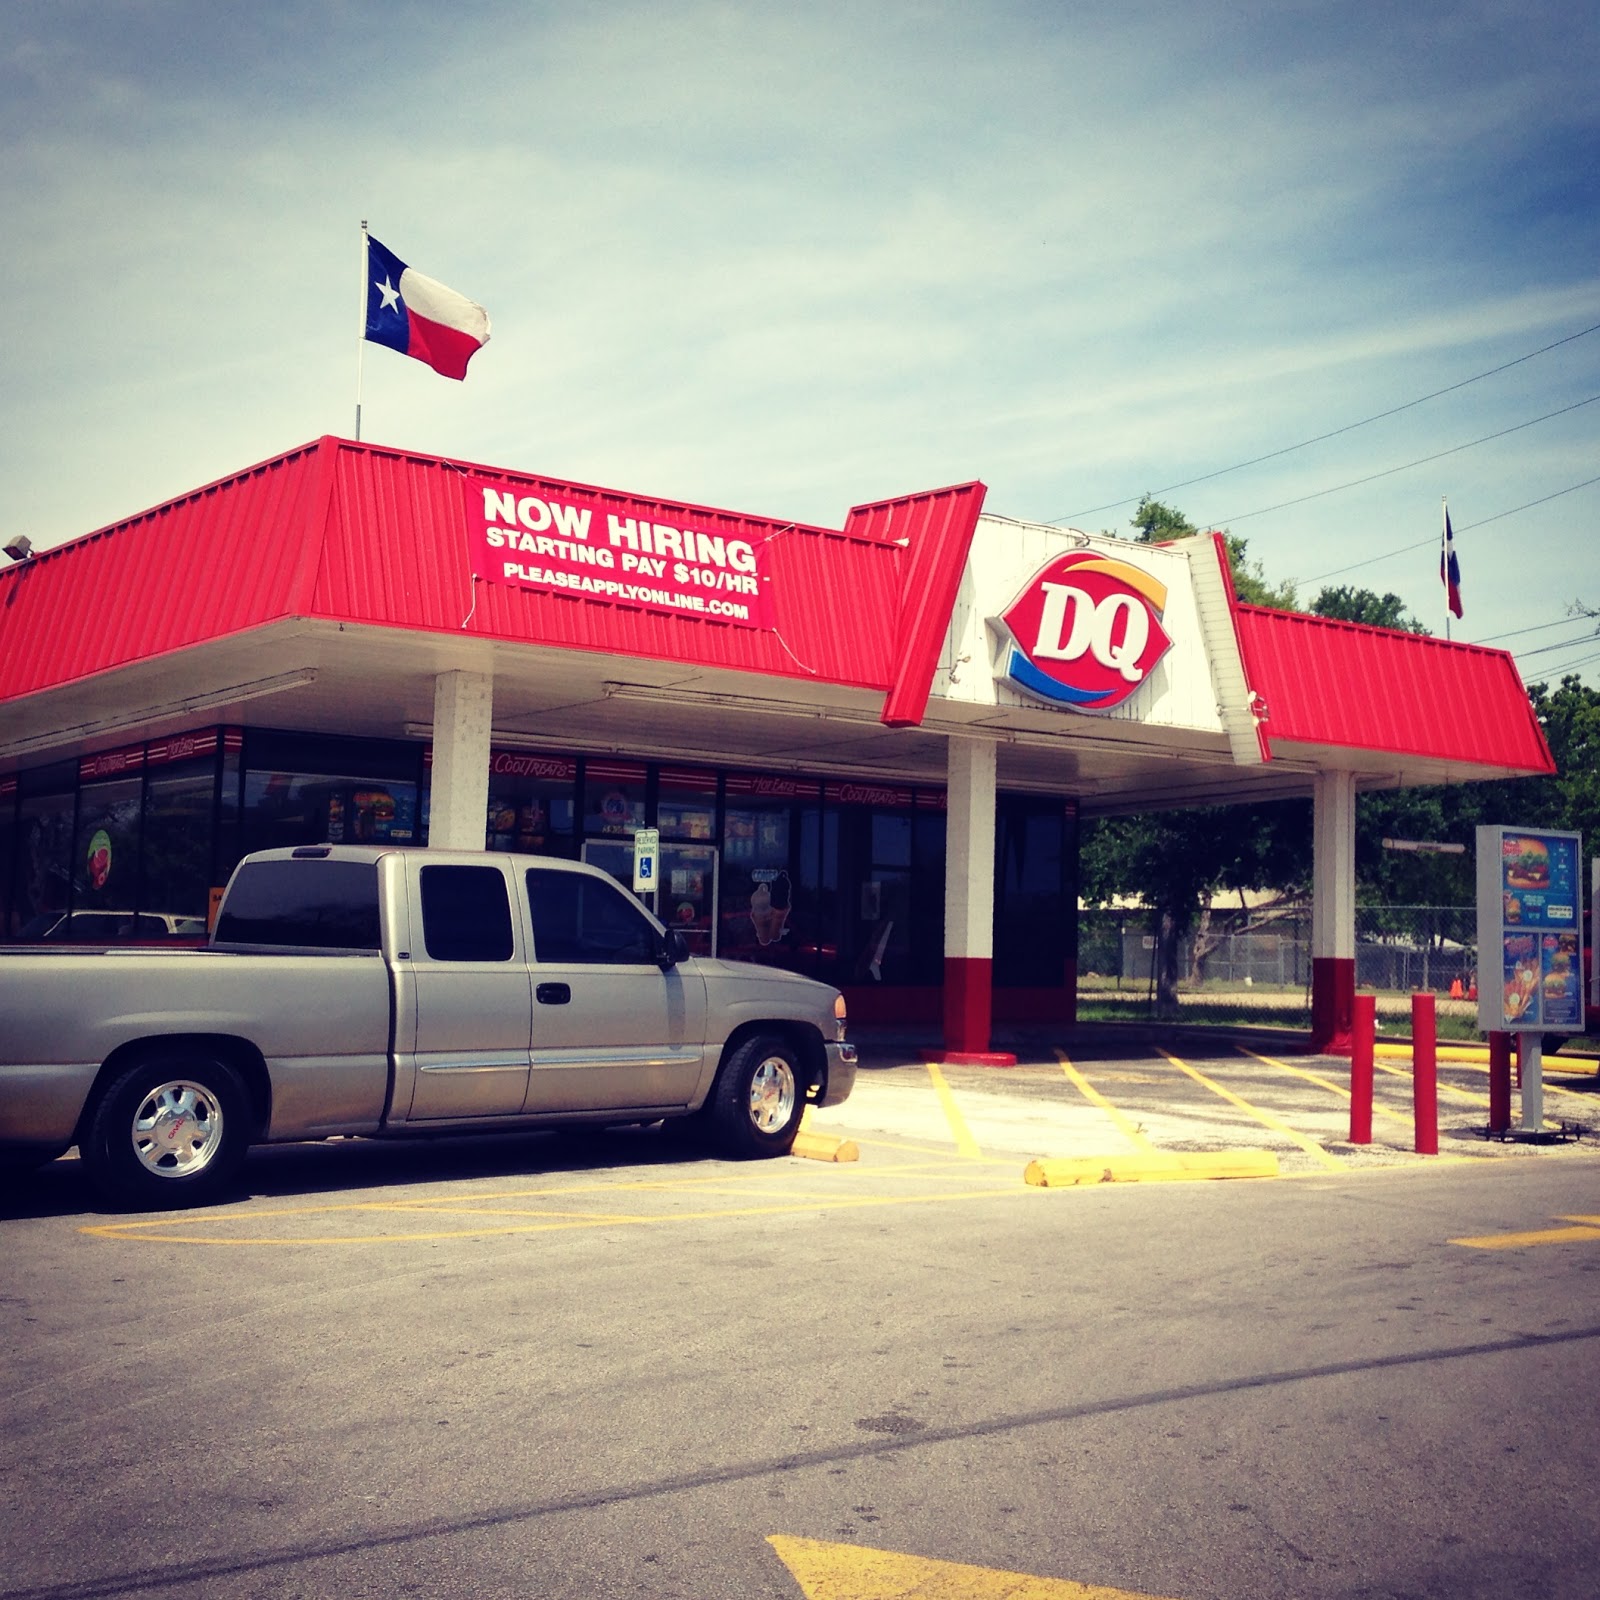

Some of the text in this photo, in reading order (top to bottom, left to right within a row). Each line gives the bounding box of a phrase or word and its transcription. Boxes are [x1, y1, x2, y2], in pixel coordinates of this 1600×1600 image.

[483, 488, 756, 573] NOW HIRING
[486, 527, 759, 595] STARTING PAY $10/HR
[504, 563, 749, 620] PLEASEAPPLYONLINE.COM
[1032, 581, 1149, 682] DQ
[168, 1118, 185, 1139] GMC
